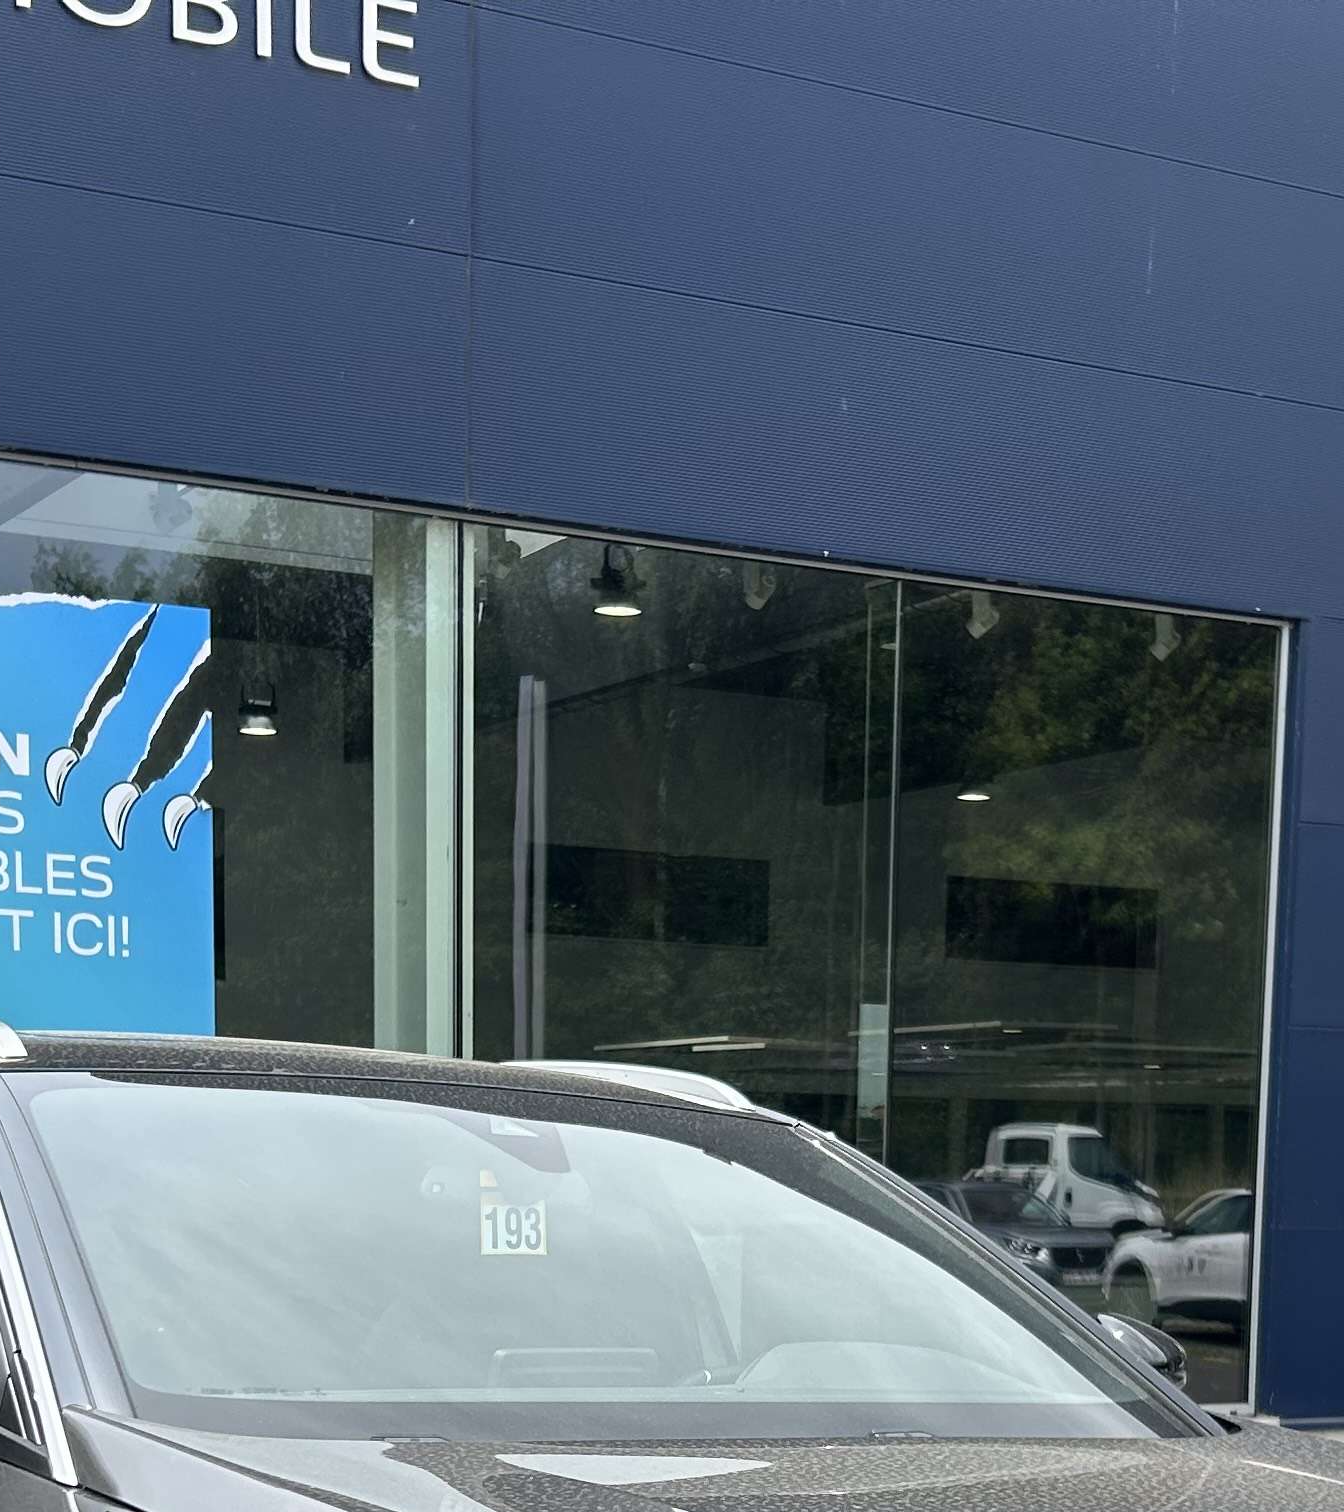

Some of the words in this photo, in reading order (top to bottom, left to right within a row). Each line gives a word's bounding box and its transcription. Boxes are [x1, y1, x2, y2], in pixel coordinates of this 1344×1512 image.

[13, 0, 420, 88] BILE
[54, 910, 131, 958] ICI!
[484, 1206, 542, 1250] 193
